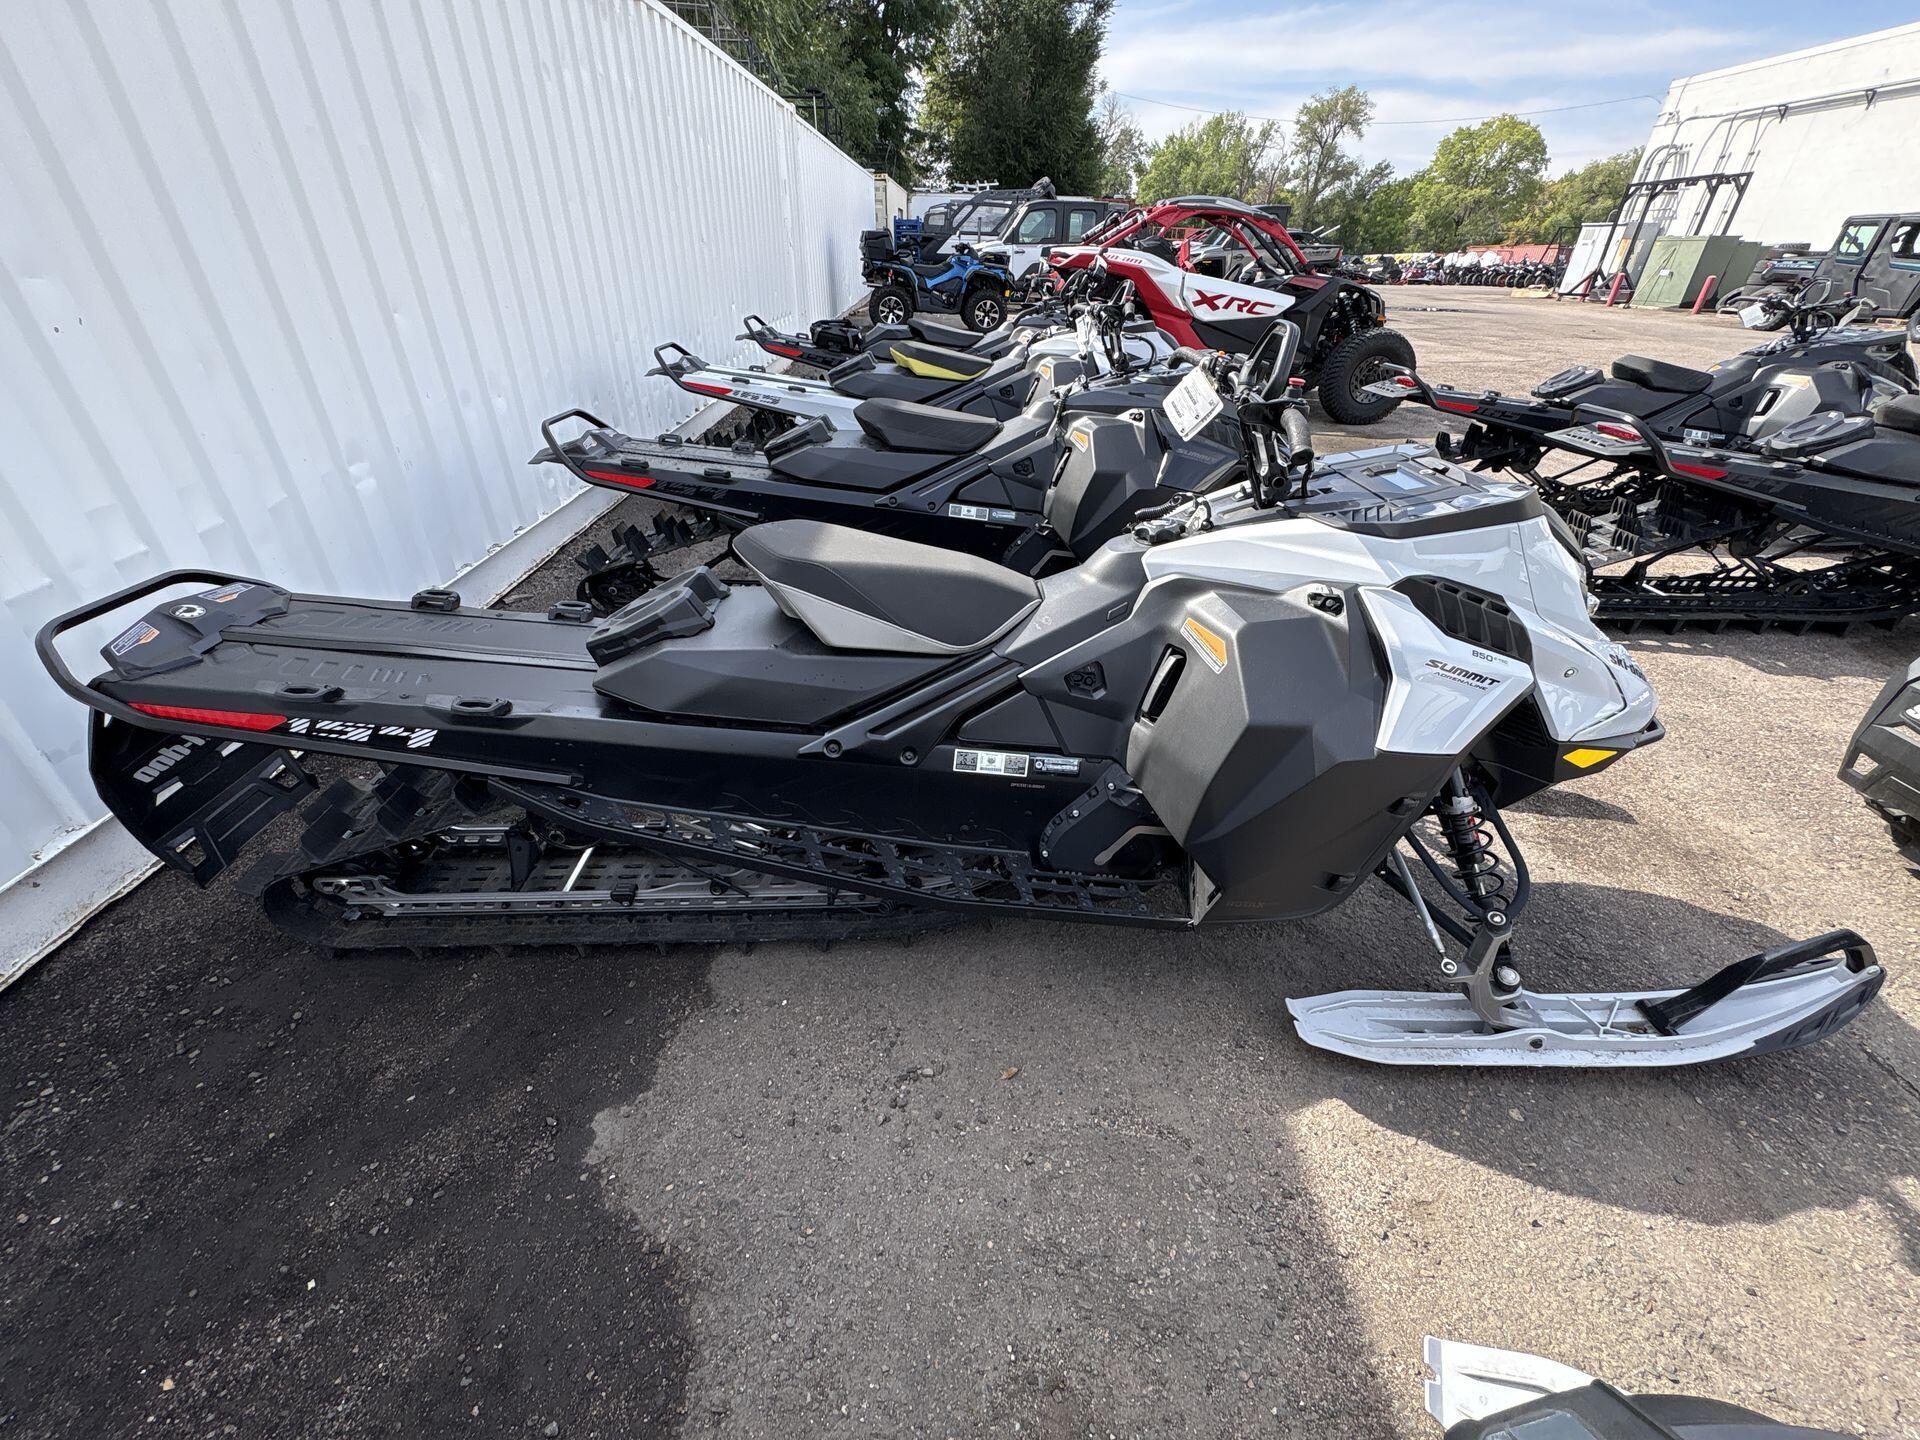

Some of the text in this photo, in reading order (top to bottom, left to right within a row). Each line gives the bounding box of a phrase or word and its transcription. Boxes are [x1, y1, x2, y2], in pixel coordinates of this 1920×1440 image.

[1193, 289, 1277, 315] XRC
[1472, 650, 1494, 662] 850
[1425, 659, 1501, 686] SUMMIT
[1433, 672, 1488, 691] ADRENALINE
[287, 717, 438, 749] 154
